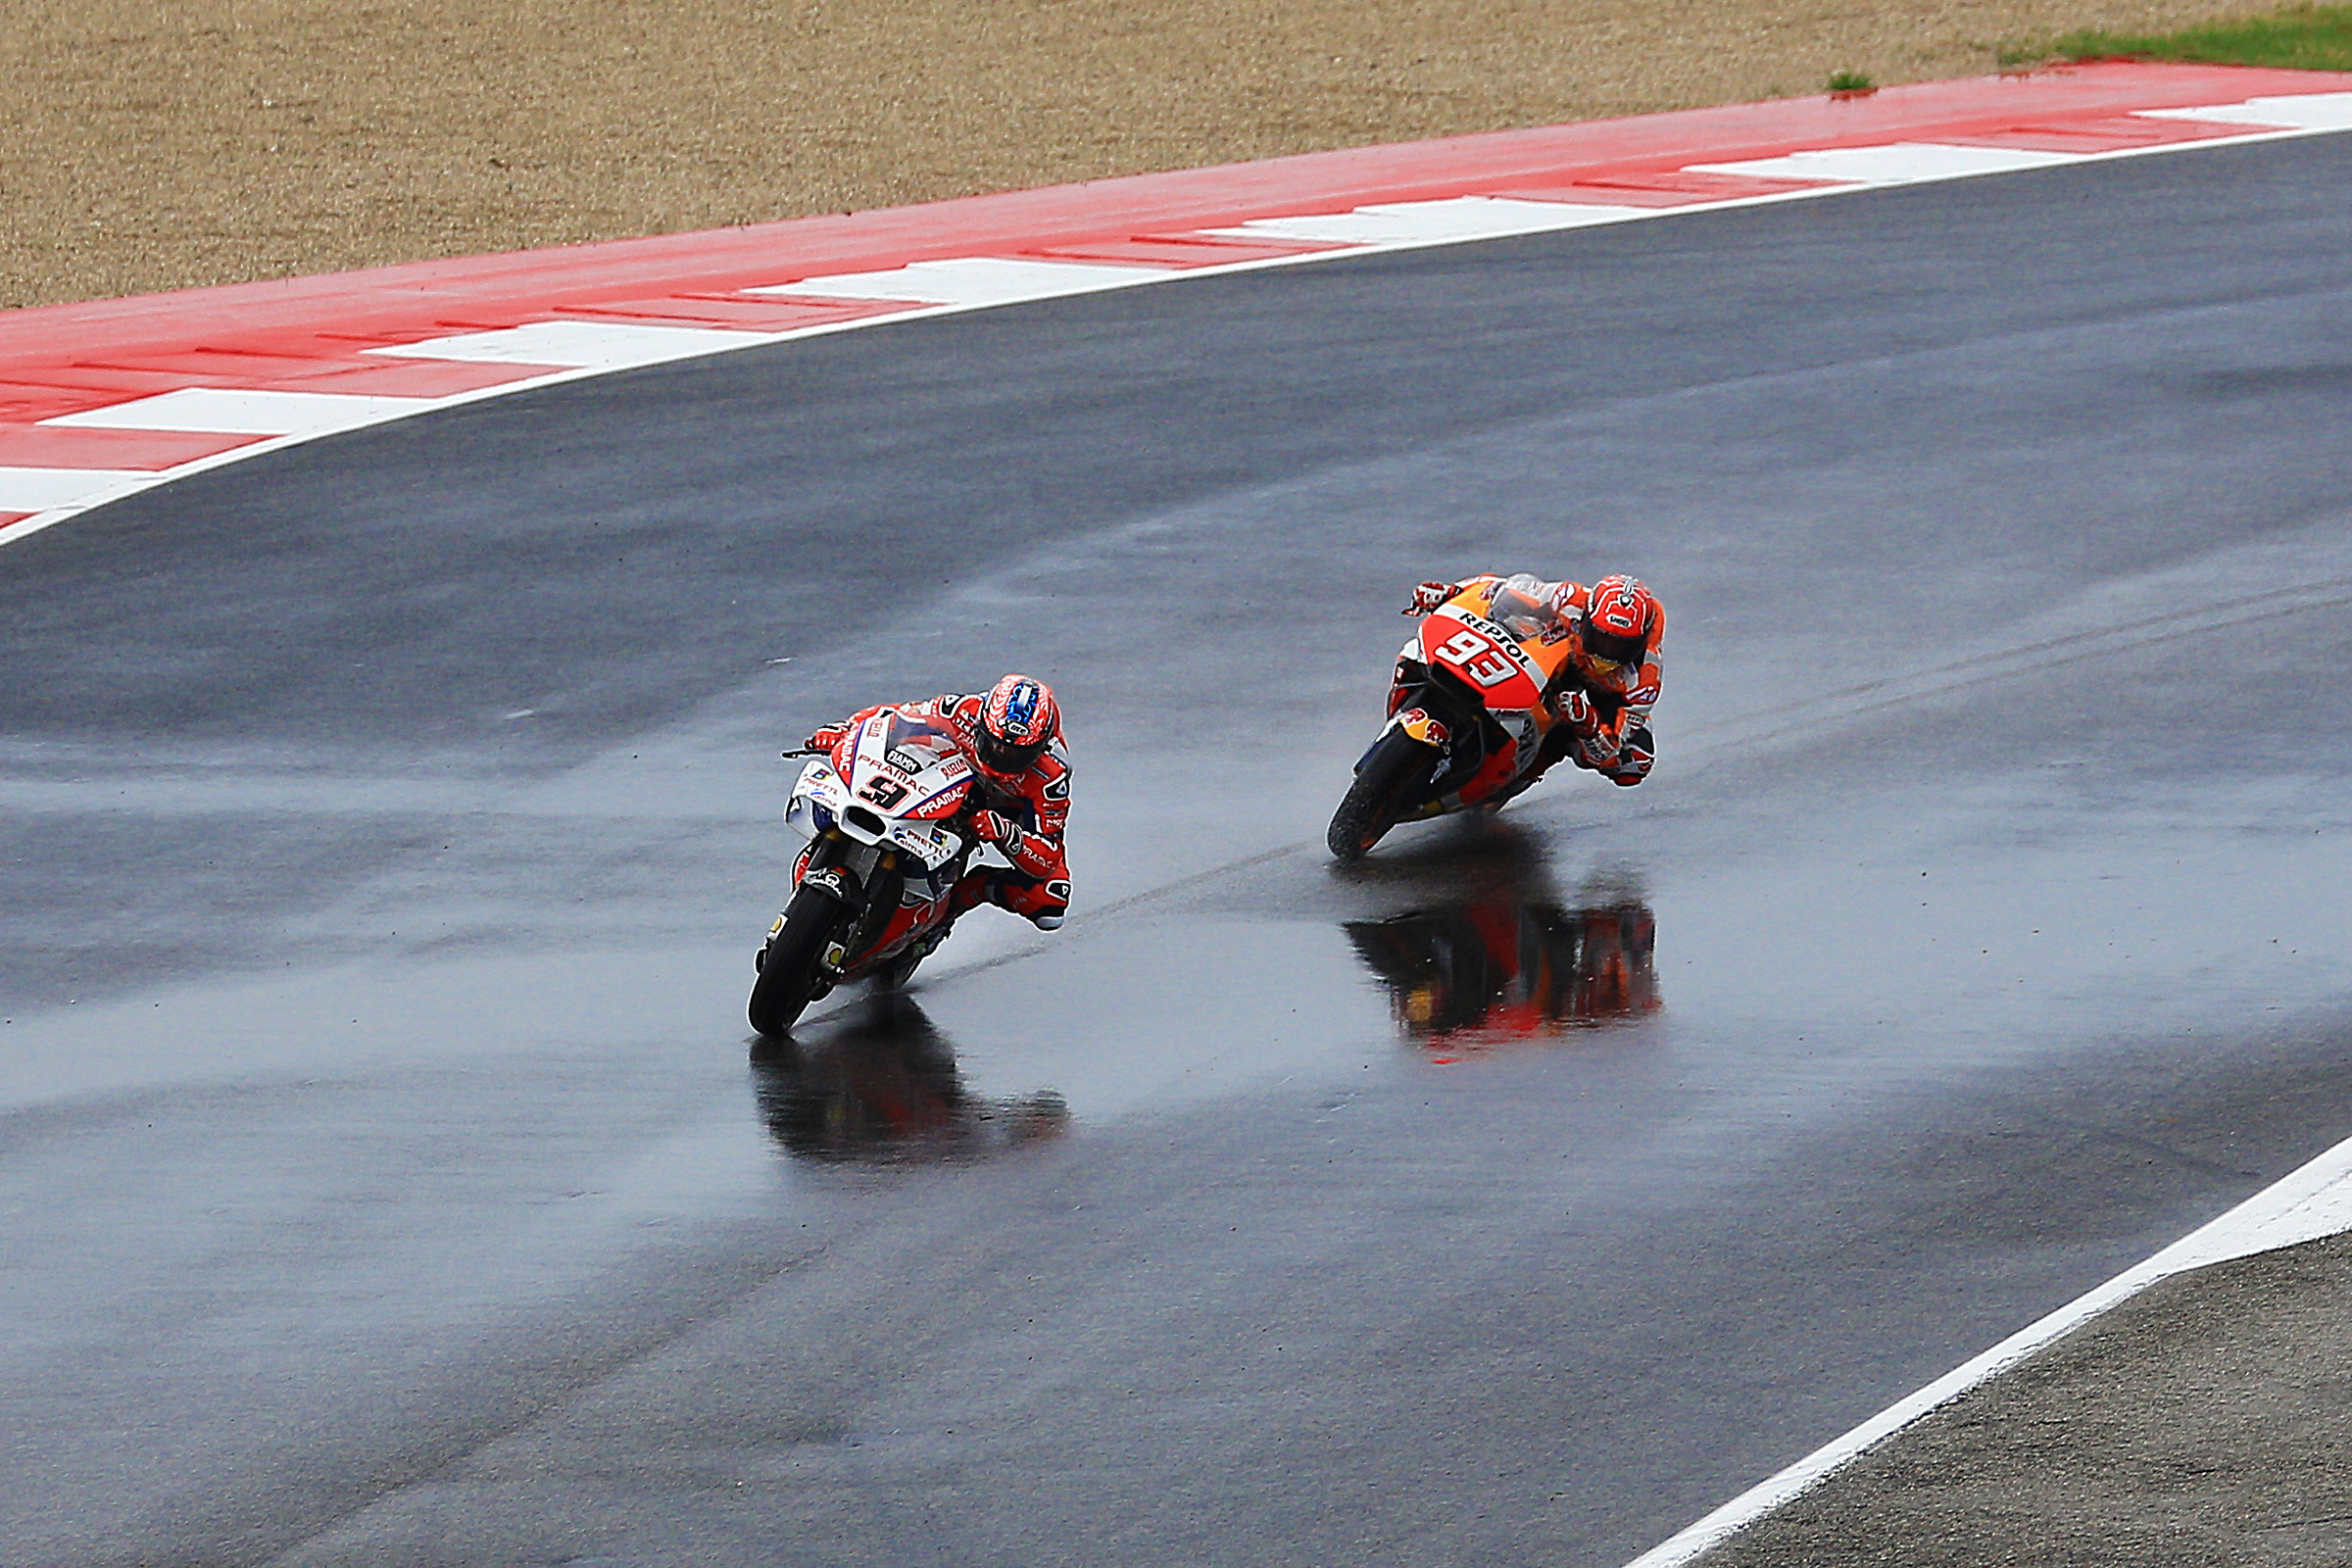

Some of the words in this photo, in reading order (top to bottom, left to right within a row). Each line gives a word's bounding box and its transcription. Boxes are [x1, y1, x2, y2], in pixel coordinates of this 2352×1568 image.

[1434, 629, 1518, 687] 93
[1459, 612, 1531, 667] REPSOL
[856, 774, 911, 812] 9
[858, 754, 930, 797] PRAMAC
[916, 786, 964, 818] PRAMAC
